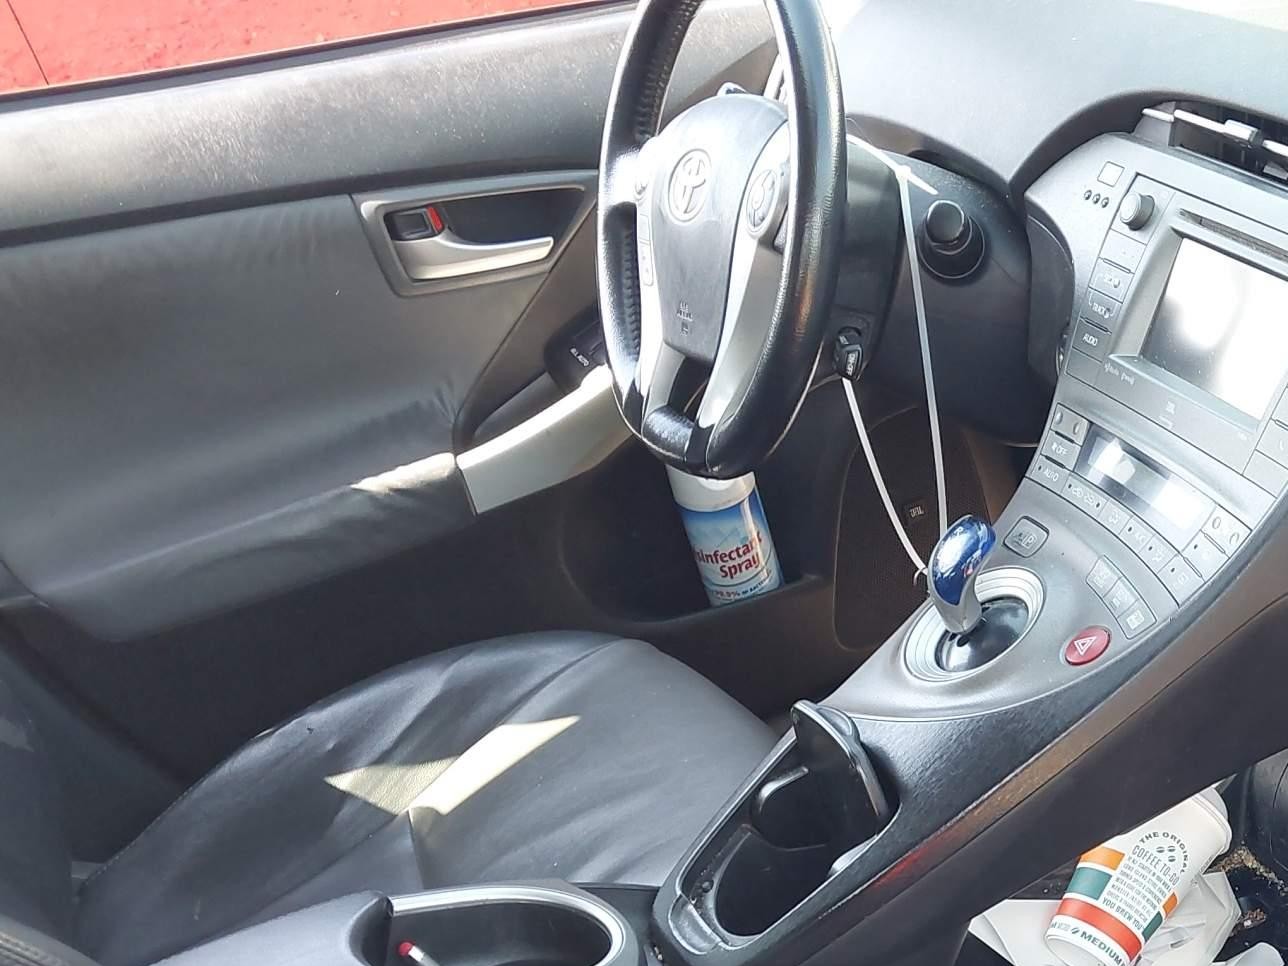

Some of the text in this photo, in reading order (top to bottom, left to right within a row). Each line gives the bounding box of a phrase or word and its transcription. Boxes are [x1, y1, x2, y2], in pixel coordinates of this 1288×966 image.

[719, 552, 760, 579] Spray
[1131, 844, 1162, 874] COFFEE
[1159, 861, 1181, 886] TO-GO
[1139, 831, 1160, 844] THE
[1162, 831, 1189, 875] ORIGINAL
[1100, 896, 1115, 910] YOU
[1114, 905, 1134, 922] BREW
[1080, 930, 1125, 966] MEDIUM
